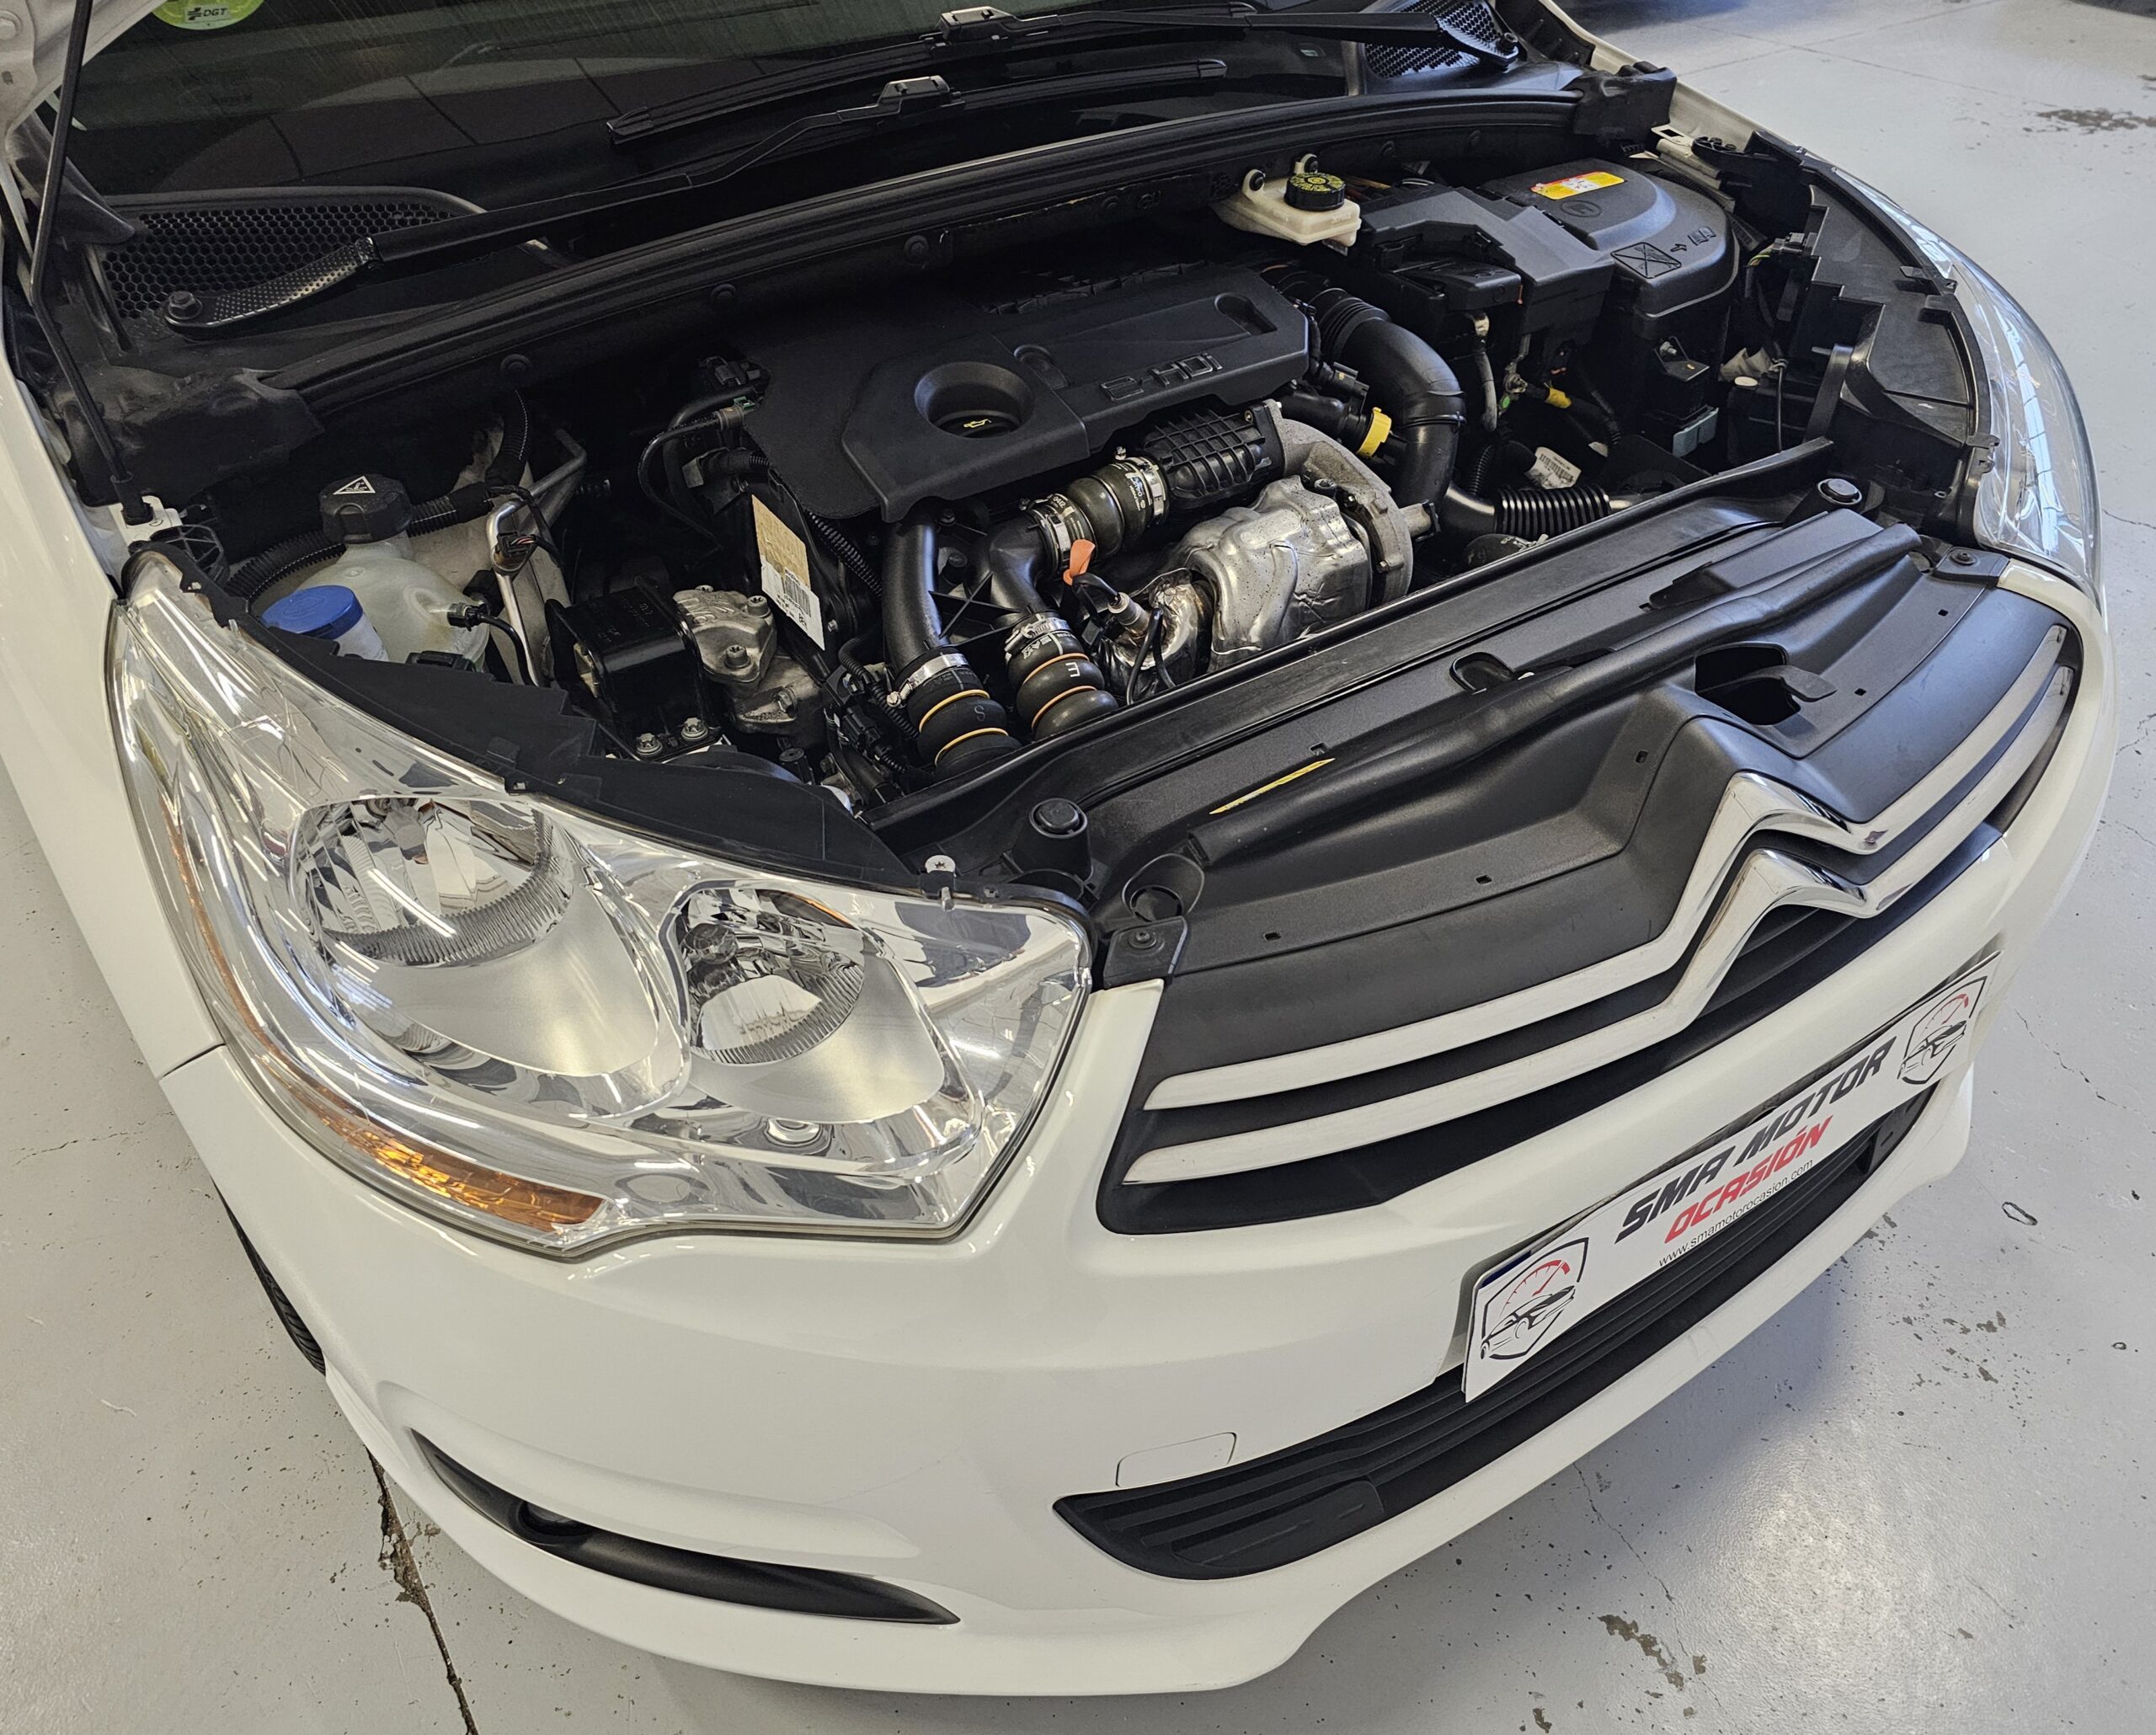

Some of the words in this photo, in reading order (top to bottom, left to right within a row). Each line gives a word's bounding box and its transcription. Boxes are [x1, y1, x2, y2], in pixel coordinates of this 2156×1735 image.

[203, 8, 227, 17] DGT
[1614, 1145, 1737, 1245] SMA
[1732, 1036, 1897, 1167] MOTOR
[1664, 1114, 1834, 1244] OCASIÓN
[1658, 1159, 1813, 1268] www.smamotorocasion.com
